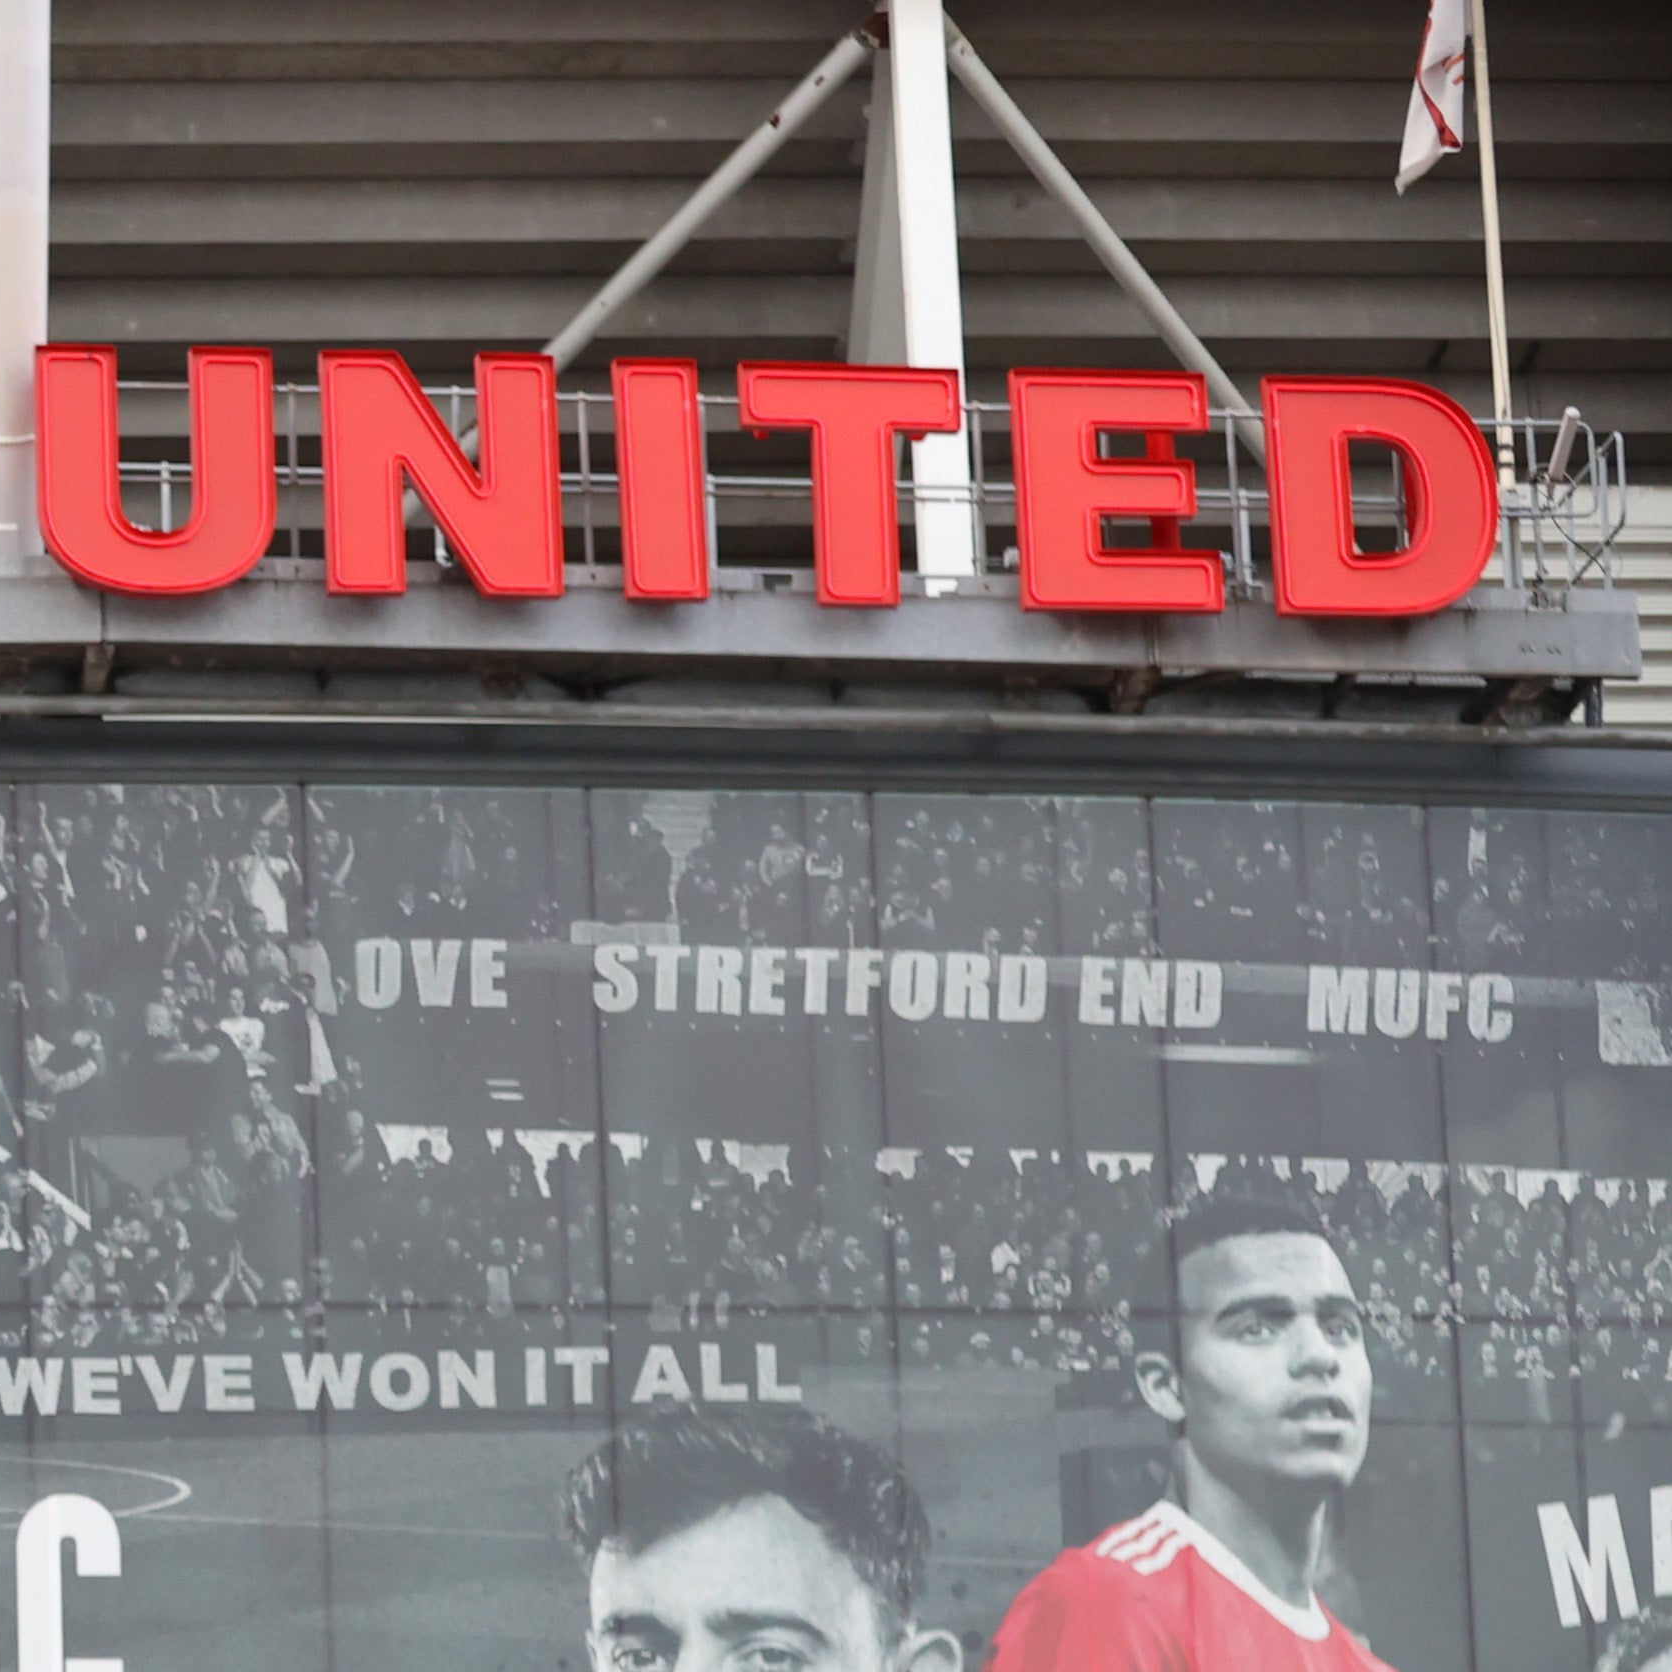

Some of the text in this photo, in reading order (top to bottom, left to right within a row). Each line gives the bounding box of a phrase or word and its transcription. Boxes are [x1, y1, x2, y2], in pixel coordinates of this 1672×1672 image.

[34, 345, 1500, 617] UNITED
[593, 943, 1047, 1022] STRETFORD
[1079, 957, 1223, 1029] END
[1307, 964, 1515, 1043] MUFC
[281, 1351, 496, 1412] WON
[523, 1347, 609, 1405] IT
[631, 1344, 803, 1402] ALL
